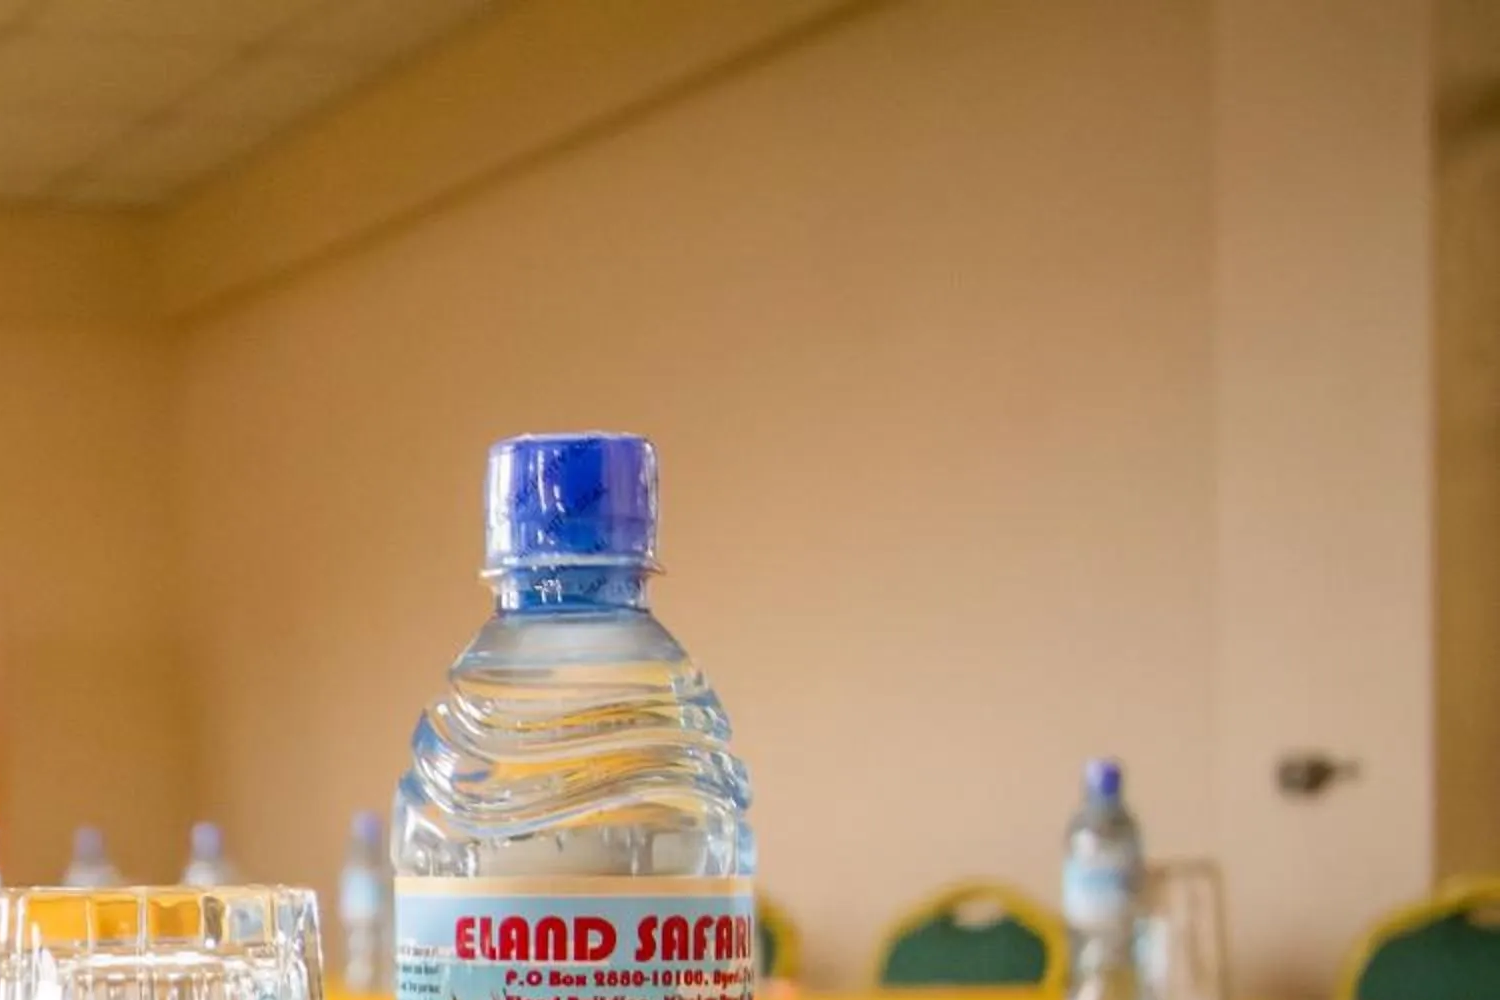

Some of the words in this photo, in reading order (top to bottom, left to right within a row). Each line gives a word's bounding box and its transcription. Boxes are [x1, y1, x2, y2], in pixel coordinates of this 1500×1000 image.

[454, 915, 617, 962] ELAND
[635, 913, 751, 962] SAFARI
[505, 969, 543, 986] P.O
[549, 970, 587, 986] Box
